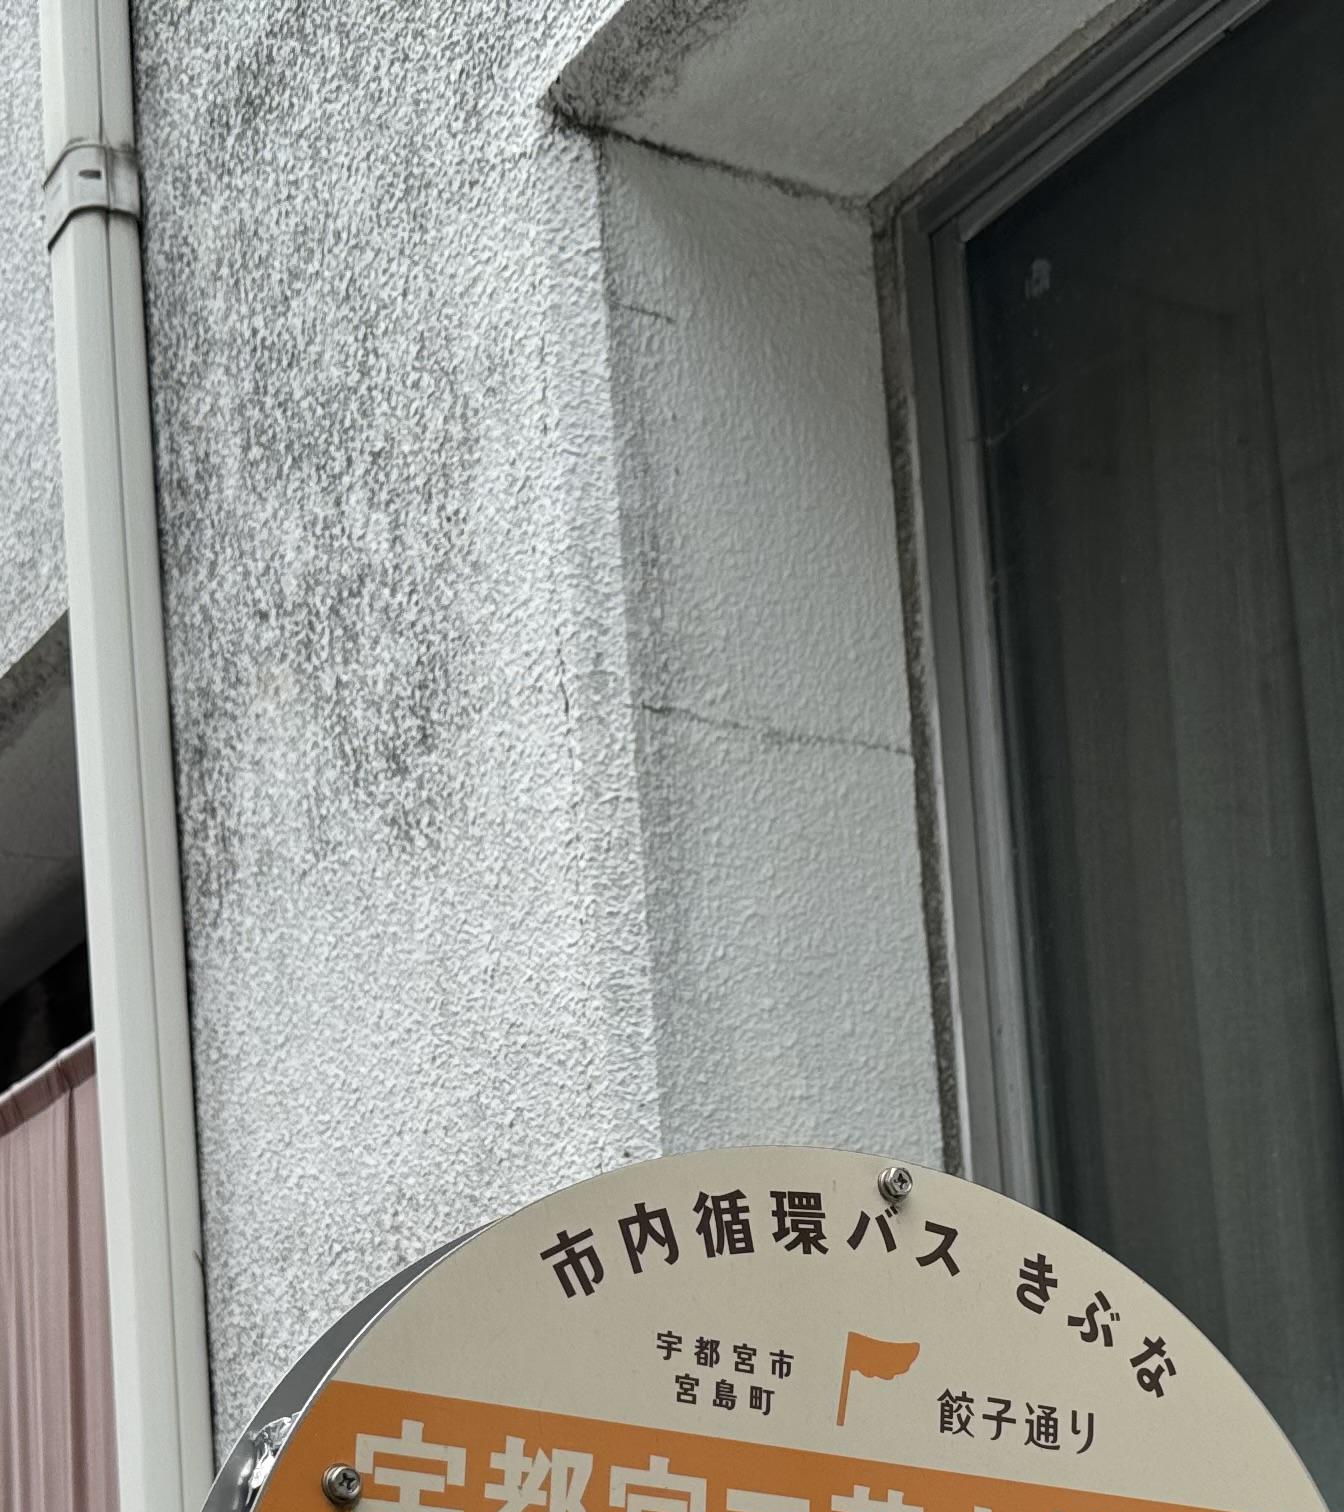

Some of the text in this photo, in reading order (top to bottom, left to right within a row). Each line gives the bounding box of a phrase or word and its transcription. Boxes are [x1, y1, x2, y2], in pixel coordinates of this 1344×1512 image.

[540, 1188, 1178, 1399] 市内循環バス きぶな
[655, 1329, 795, 1381] 宇都宮市
[673, 1372, 776, 1417] 宮島町
[936, 1387, 1098, 1456] 餃子通り
